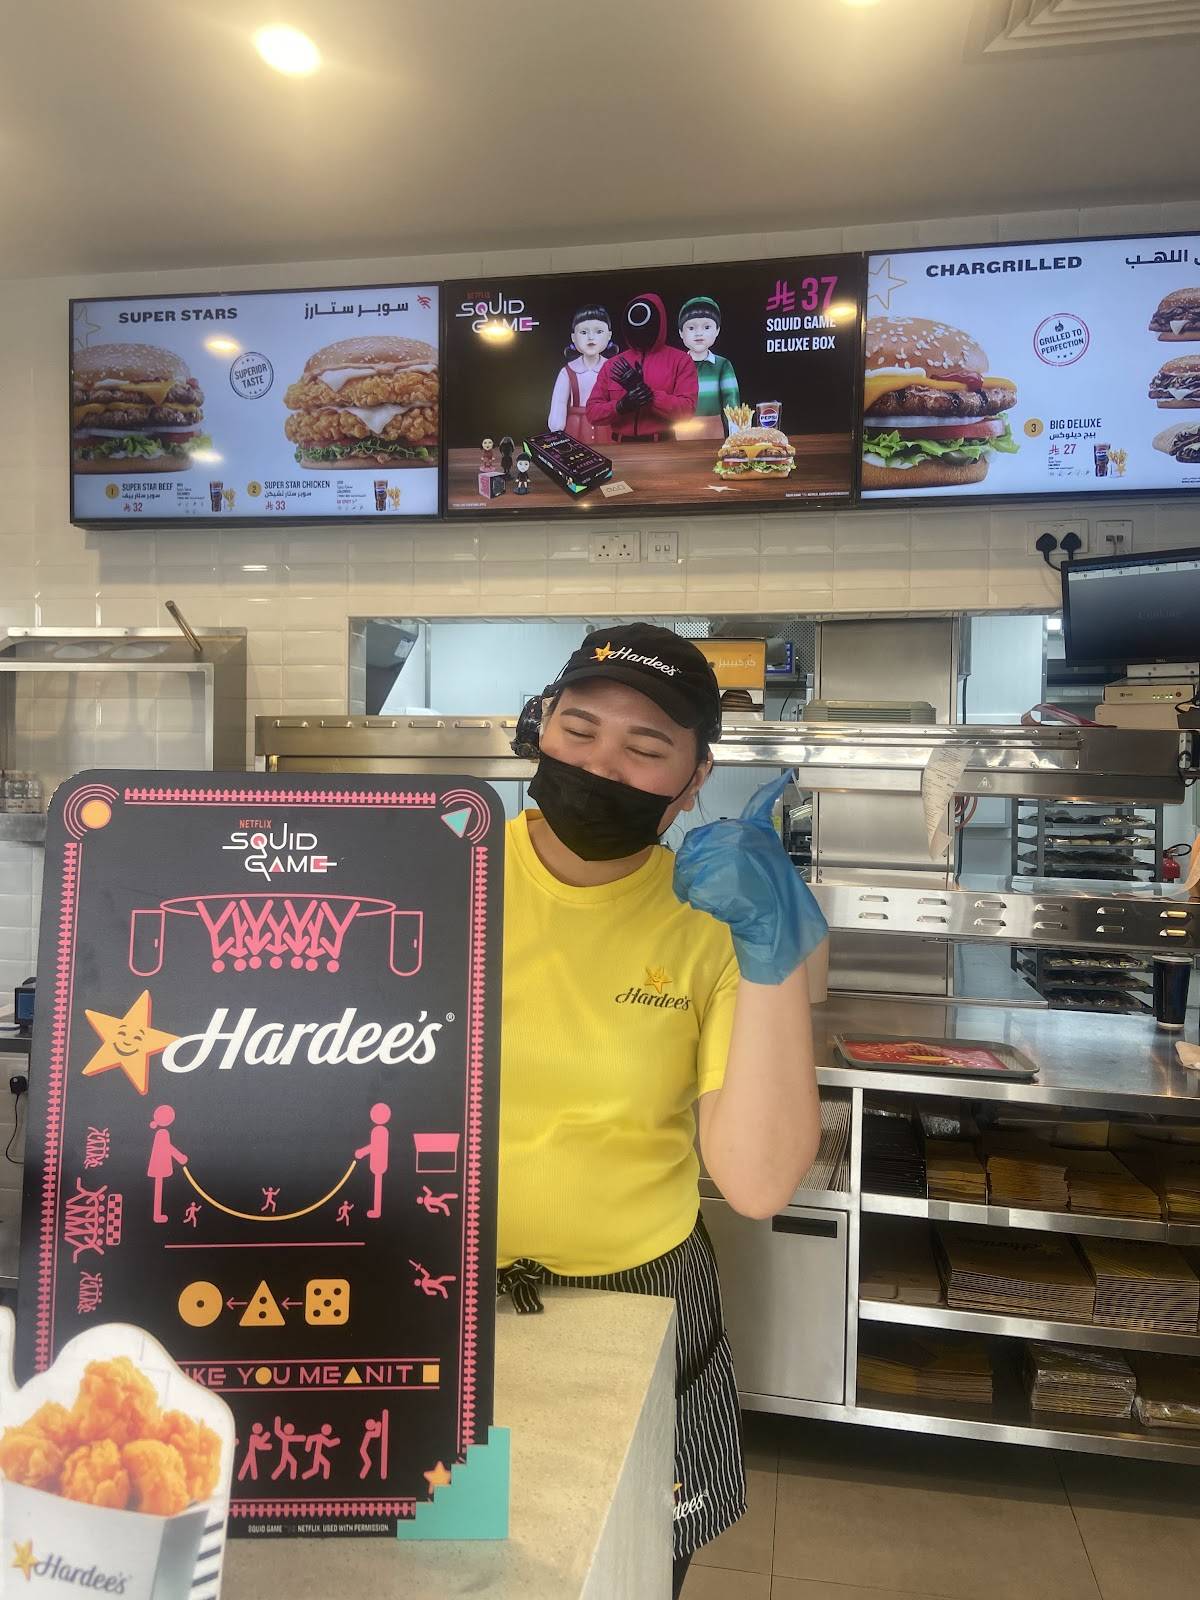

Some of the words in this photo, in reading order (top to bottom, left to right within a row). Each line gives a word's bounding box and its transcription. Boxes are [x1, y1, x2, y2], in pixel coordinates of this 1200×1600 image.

[926, 256, 1082, 277] CHARGRILLED
[1125, 249, 1188, 269] اللهب
[801, 276, 838, 311] 37
[304, 301, 354, 319] ستارز
[357, 302, 409, 317] سوبر
[456, 292, 525, 317] SQUID
[119, 310, 176, 323] SUPER
[181, 308, 238, 321] STARS
[766, 317, 801, 332] SQUID
[803, 315, 837, 329] GAME
[766, 337, 810, 353] DELUXE
[812, 335, 836, 350] BOX
[1040, 331, 1070, 346] GRILLED
[1072, 328, 1082, 337] TO
[1041, 337, 1084, 354] PERFECTION
[234, 363, 268, 380] SUPERIOR
[241, 375, 265, 388] TASTE
[1050, 419, 1065, 430] BIG
[1067, 418, 1102, 429] DELUXE
[1063, 443, 1077, 455] 27
[122, 482, 141, 491] SUPER
[142, 482, 158, 491] STAR
[158, 482, 173, 491] BEEF
[264, 481, 284, 489] SUPER
[285, 480, 301, 489] STAR
[302, 480, 330, 489] CHICKEN
[133, 502, 143, 512] 32
[275, 500, 286, 511] 33
[239, 819, 272, 829] NETFLIX
[222, 822, 318, 851] SQUID
[244, 854, 338, 881] GAME
[615, 987, 691, 1011] Hardee's
[236, 1366, 291, 1386] YOU
[672, 1492, 703, 1521] dee's
[248, 1524, 266, 1533] SQUID
[266, 1524, 282, 1533] GAME
[322, 1524, 337, 1533] USED
[338, 1523, 353, 1532] WITH
[353, 1523, 389, 1532] PERMISSION
[33, 1552, 128, 1595] Hardee's
